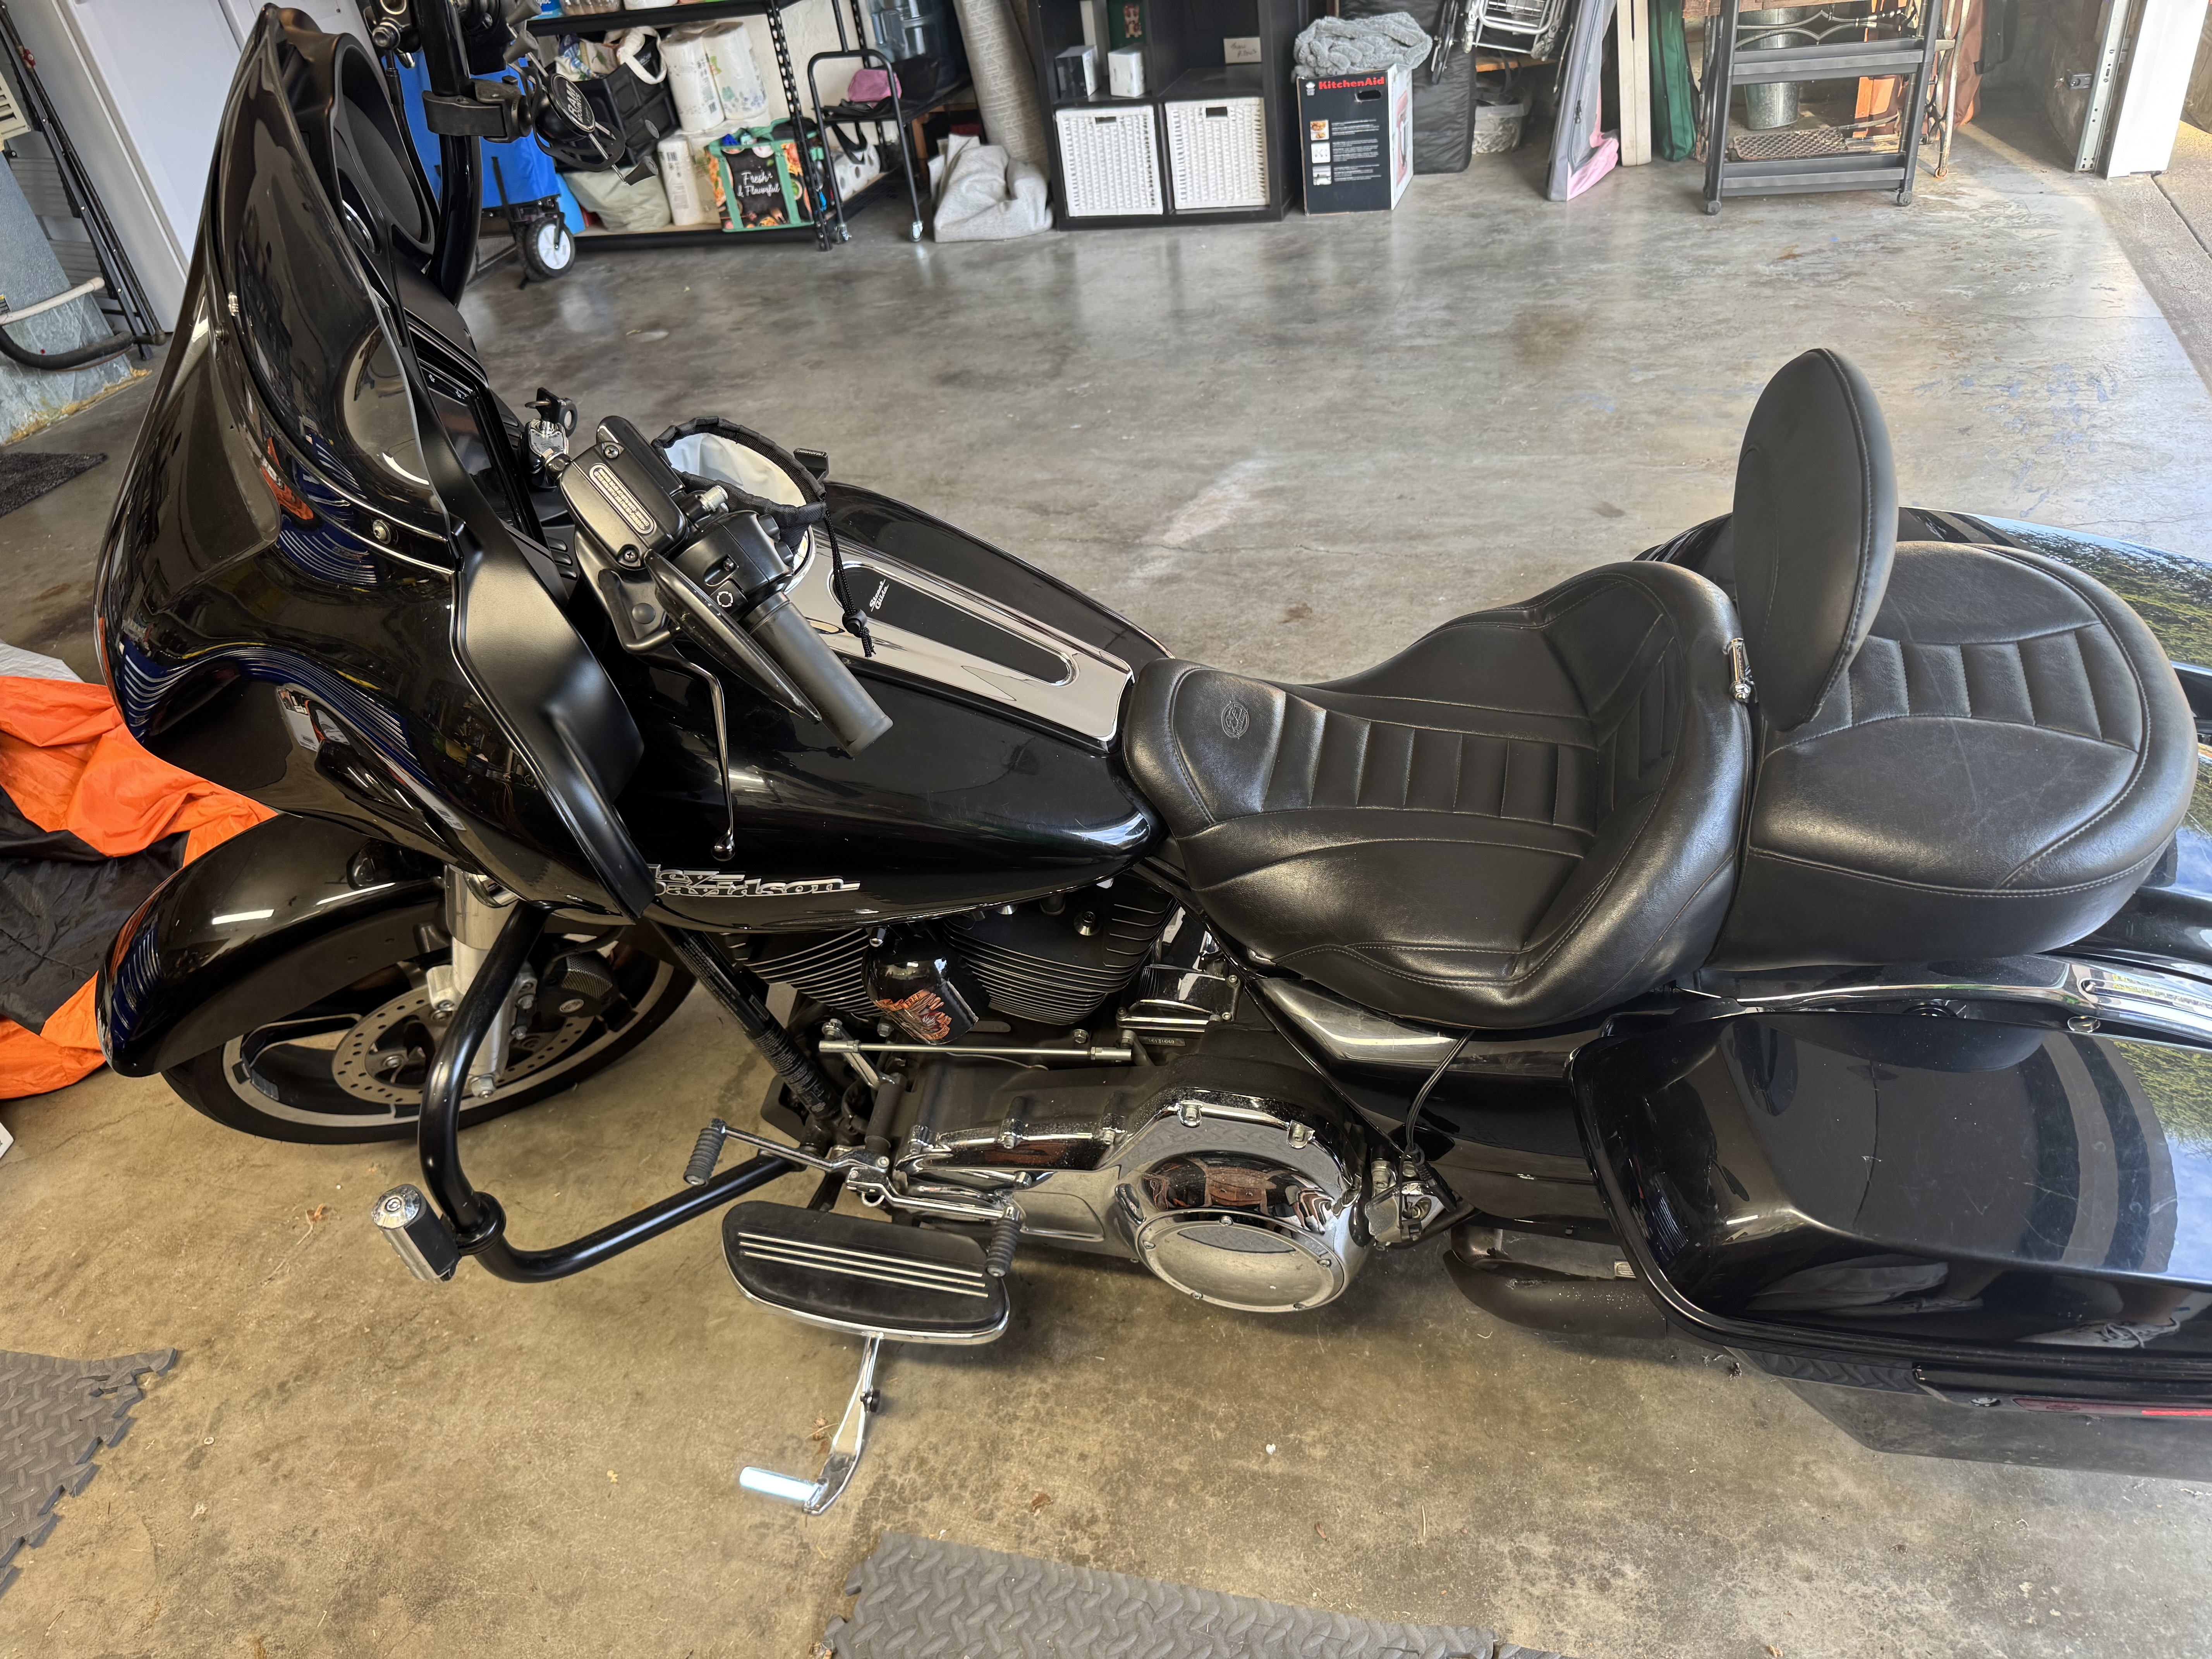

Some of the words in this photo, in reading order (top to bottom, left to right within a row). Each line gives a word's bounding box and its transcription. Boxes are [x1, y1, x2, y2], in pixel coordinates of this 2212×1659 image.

[1319, 77, 1385, 89] KitchenAid
[575, 93, 583, 123] MOUNTS
[741, 170, 771, 185] Fresh
[869, 579, 886, 612] Street
[875, 584, 890, 610] Glide
[905, 993, 922, 1007] FREE
